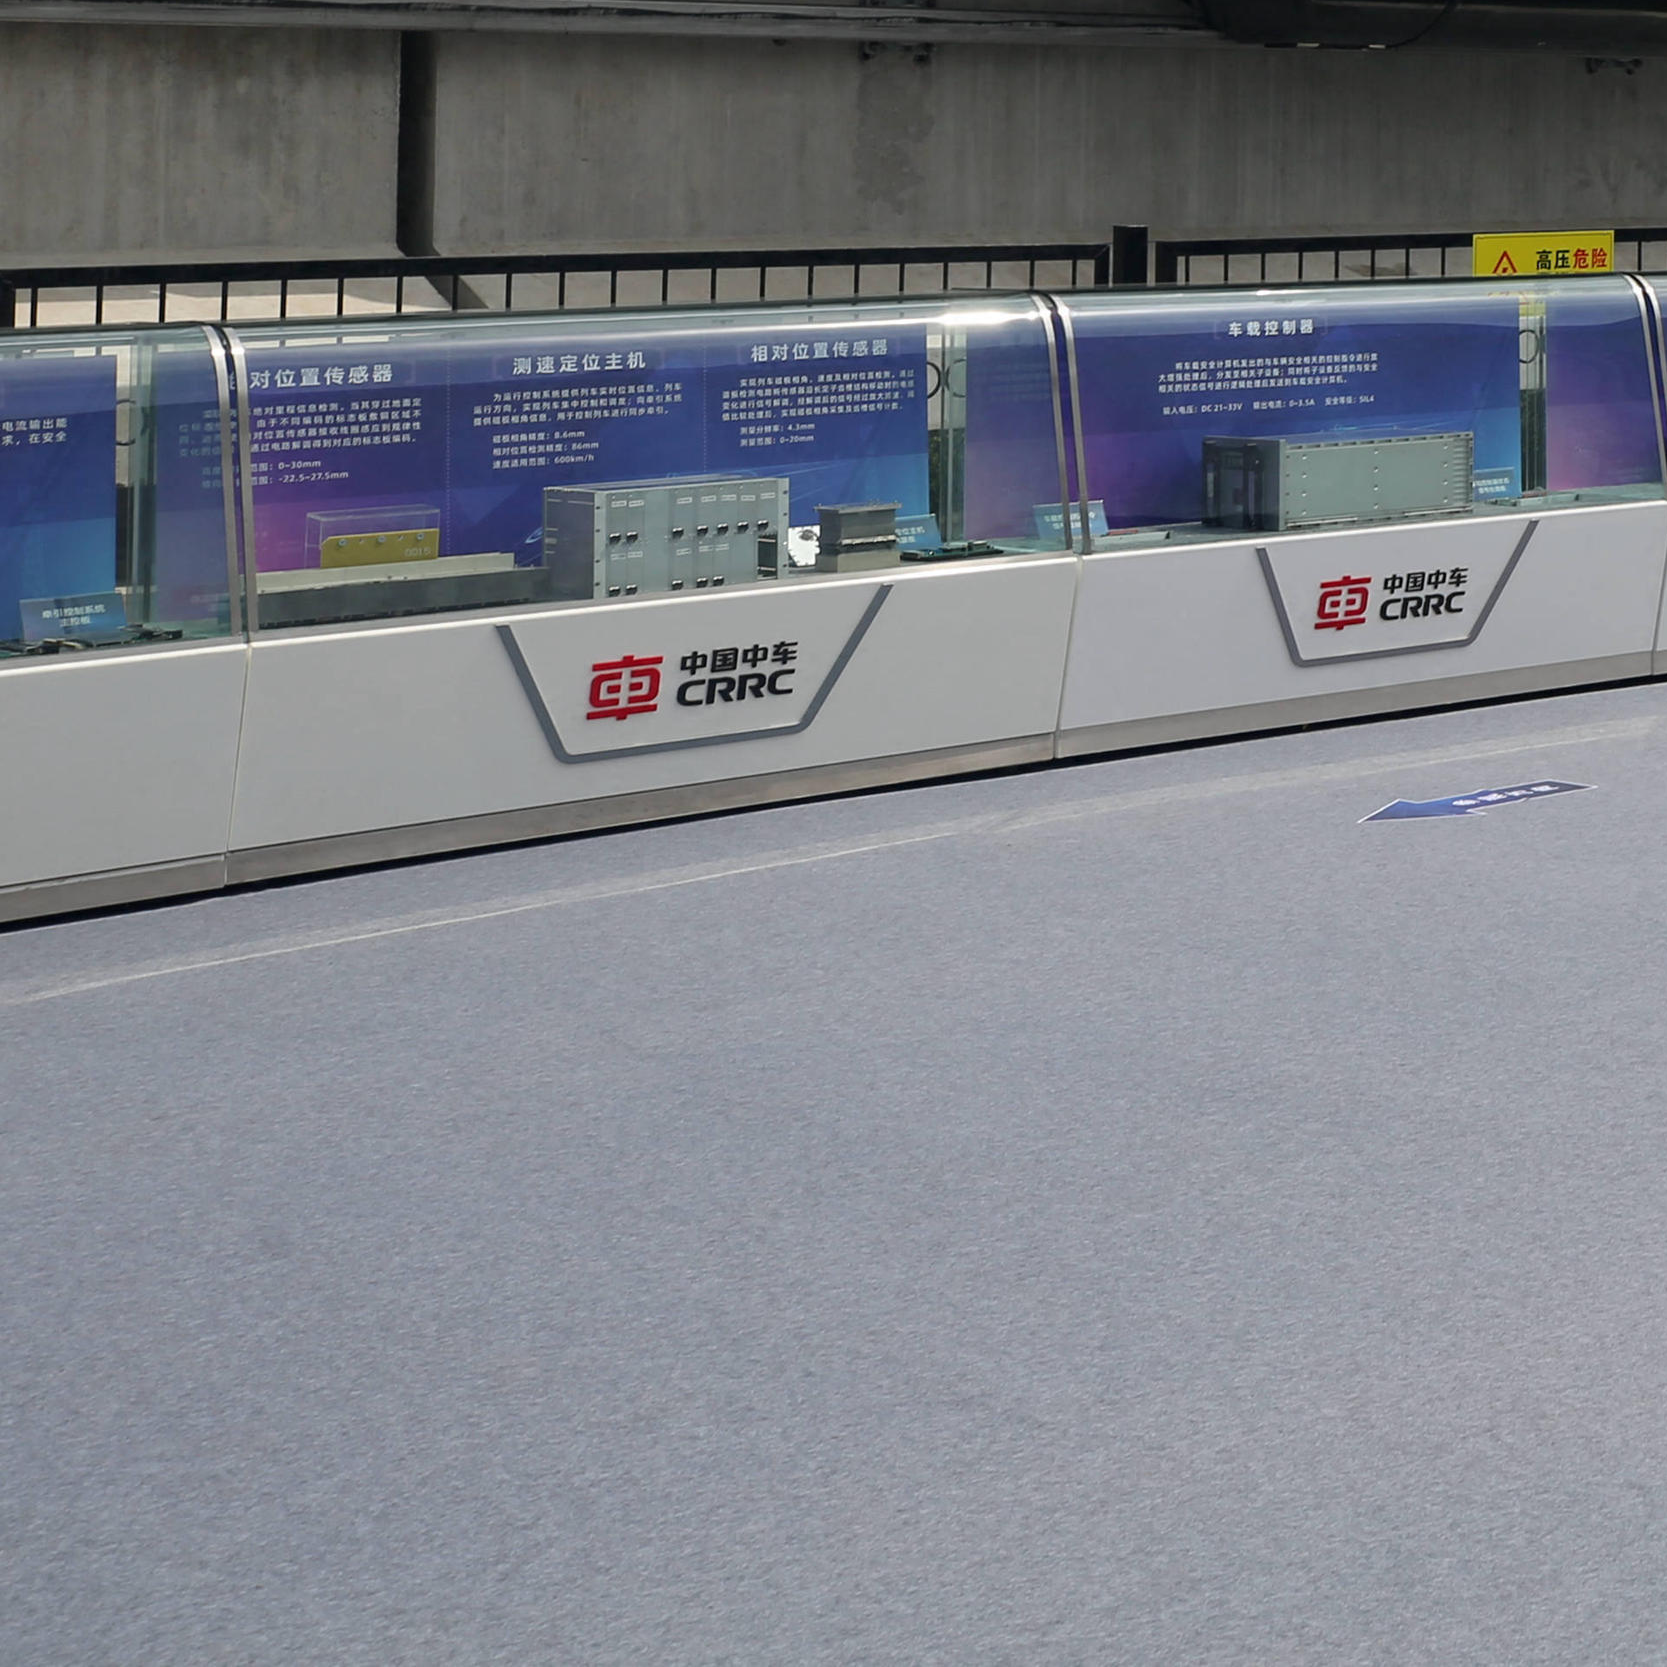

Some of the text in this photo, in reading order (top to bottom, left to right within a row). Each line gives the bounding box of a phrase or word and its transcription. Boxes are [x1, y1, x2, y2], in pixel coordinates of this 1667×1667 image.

[1536, 247, 1608, 271] 高压危险
[1228, 319, 1314, 337] 车载控制器
[751, 338, 888, 362] 相对位置传感器
[512, 352, 646, 375] 测速定位主机
[1382, 567, 1469, 594] 中国中车
[1379, 590, 1466, 621] CRRC
[680, 641, 798, 675] 中国中车
[676, 669, 796, 707] CRRC
